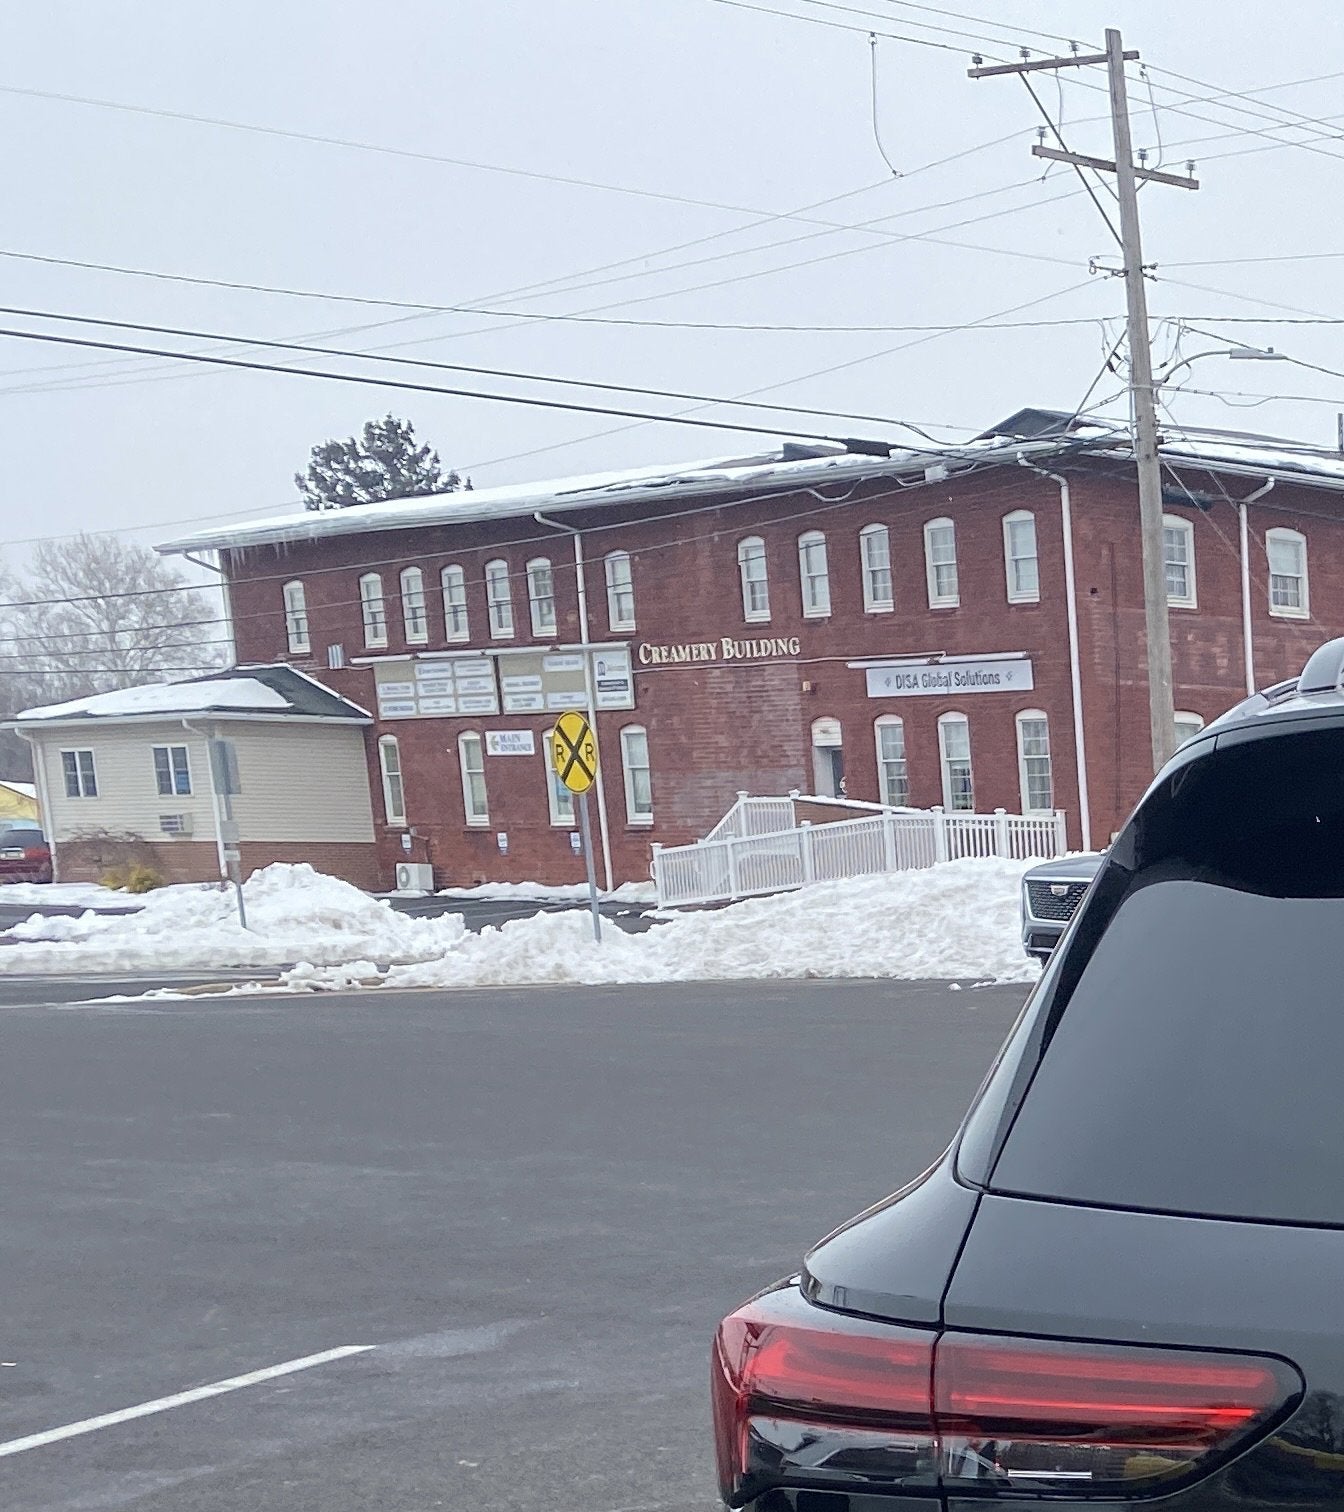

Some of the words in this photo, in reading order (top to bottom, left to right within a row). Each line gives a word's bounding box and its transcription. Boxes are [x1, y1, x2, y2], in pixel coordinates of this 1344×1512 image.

[639, 642, 717, 665] CREAMERY
[720, 636, 801, 660] BUILDING
[896, 674, 919, 689] DISA
[921, 670, 952, 688] Global
[954, 669, 1001, 687] Solutions
